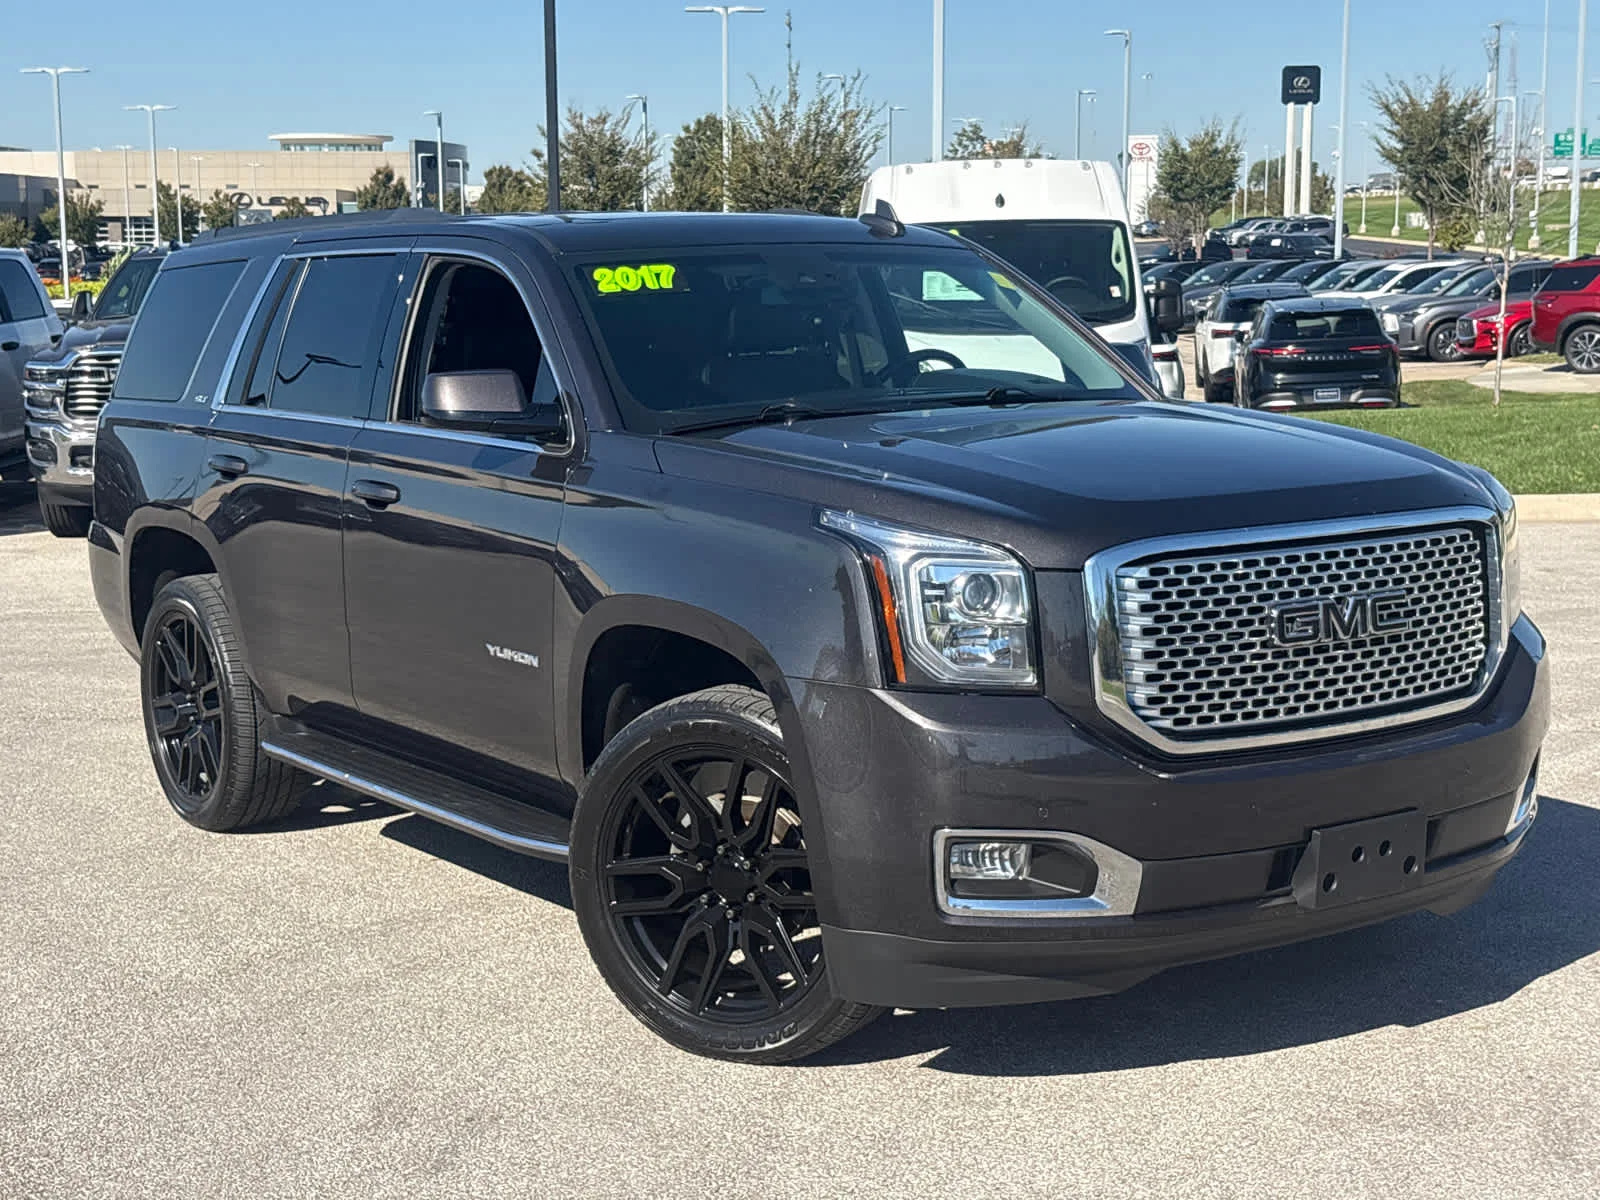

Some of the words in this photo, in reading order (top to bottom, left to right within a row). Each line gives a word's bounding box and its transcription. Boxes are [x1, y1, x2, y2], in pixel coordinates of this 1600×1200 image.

[257, 196, 330, 207] LEUS
[593, 264, 676, 293] 2017
[1269, 590, 1409, 648] GMC
[486, 643, 539, 668] YUKON
